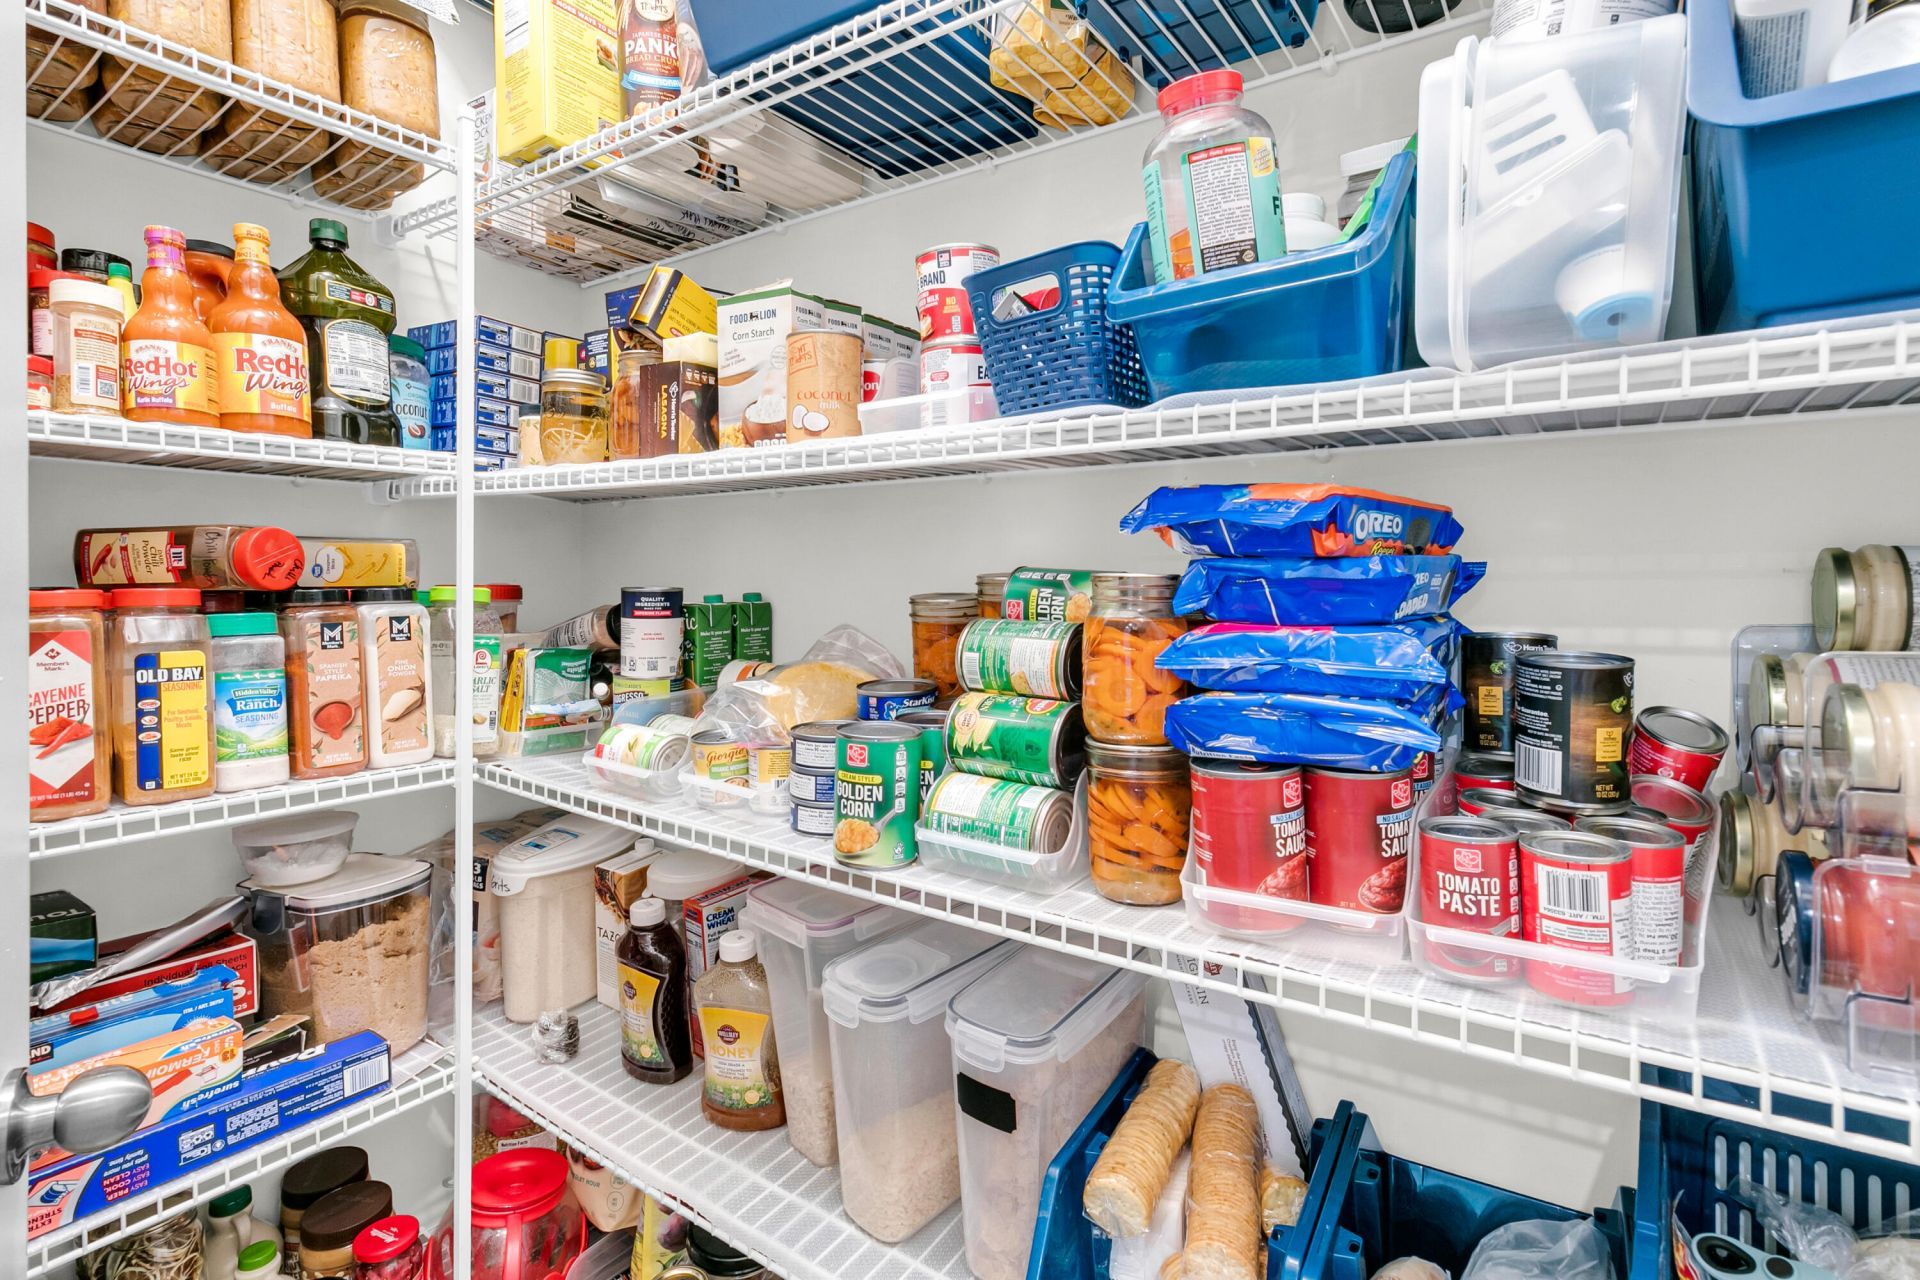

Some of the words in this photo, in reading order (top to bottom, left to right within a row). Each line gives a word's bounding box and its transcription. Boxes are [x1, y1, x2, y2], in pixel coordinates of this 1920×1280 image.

[730, 314, 749, 325] FOOD
[760, 309, 777, 320] LION
[796, 306, 808, 315] FOOD
[828, 318, 841, 327] FOOD
[733, 330, 750, 341] Corn
[751, 327, 775, 338] Starch
[124, 356, 197, 379] RedHot
[128, 376, 191, 395] Wings
[271, 403, 297, 413] Buffalo
[819, 400, 841, 409] milk
[660, 384, 668, 439] LASAGNA
[1355, 513, 1402, 540] OREO
[141, 540, 153, 574] Powder
[149, 546, 159, 567] Chili
[387, 664, 416, 672] ONION
[136, 668, 168, 683] OLD
[315, 673, 352, 682] PAPRIKA
[163, 682, 203, 692] SEASONING
[235, 689, 259, 697] Hidden
[259, 687, 277, 696] Valley
[235, 712, 279, 724] SEASONING
[841, 772, 857, 781] CREAM
[858, 775, 875, 783] STYLE
[837, 781, 884, 802] GOLDEN
[840, 800, 874, 818] CORN
[1437, 871, 1500, 895] TOMATO
[1439, 889, 1501, 917] PASTE
[706, 906, 735, 922] CREAM
[707, 914, 736, 930] WHEAT
[216, 953, 247, 966] Sheets
[709, 1046, 754, 1059] HONEY
[181, 1079, 240, 1110] surefresh
[122, 1158, 134, 1168] you
[136, 1154, 149, 1163] gets
[104, 1165, 120, 1177] more
[131, 1163, 150, 1173] EASY
[103, 1169, 130, 1186] CLEAN
[131, 1171, 150, 1182] EASY
[130, 1180, 148, 1192] EASY
